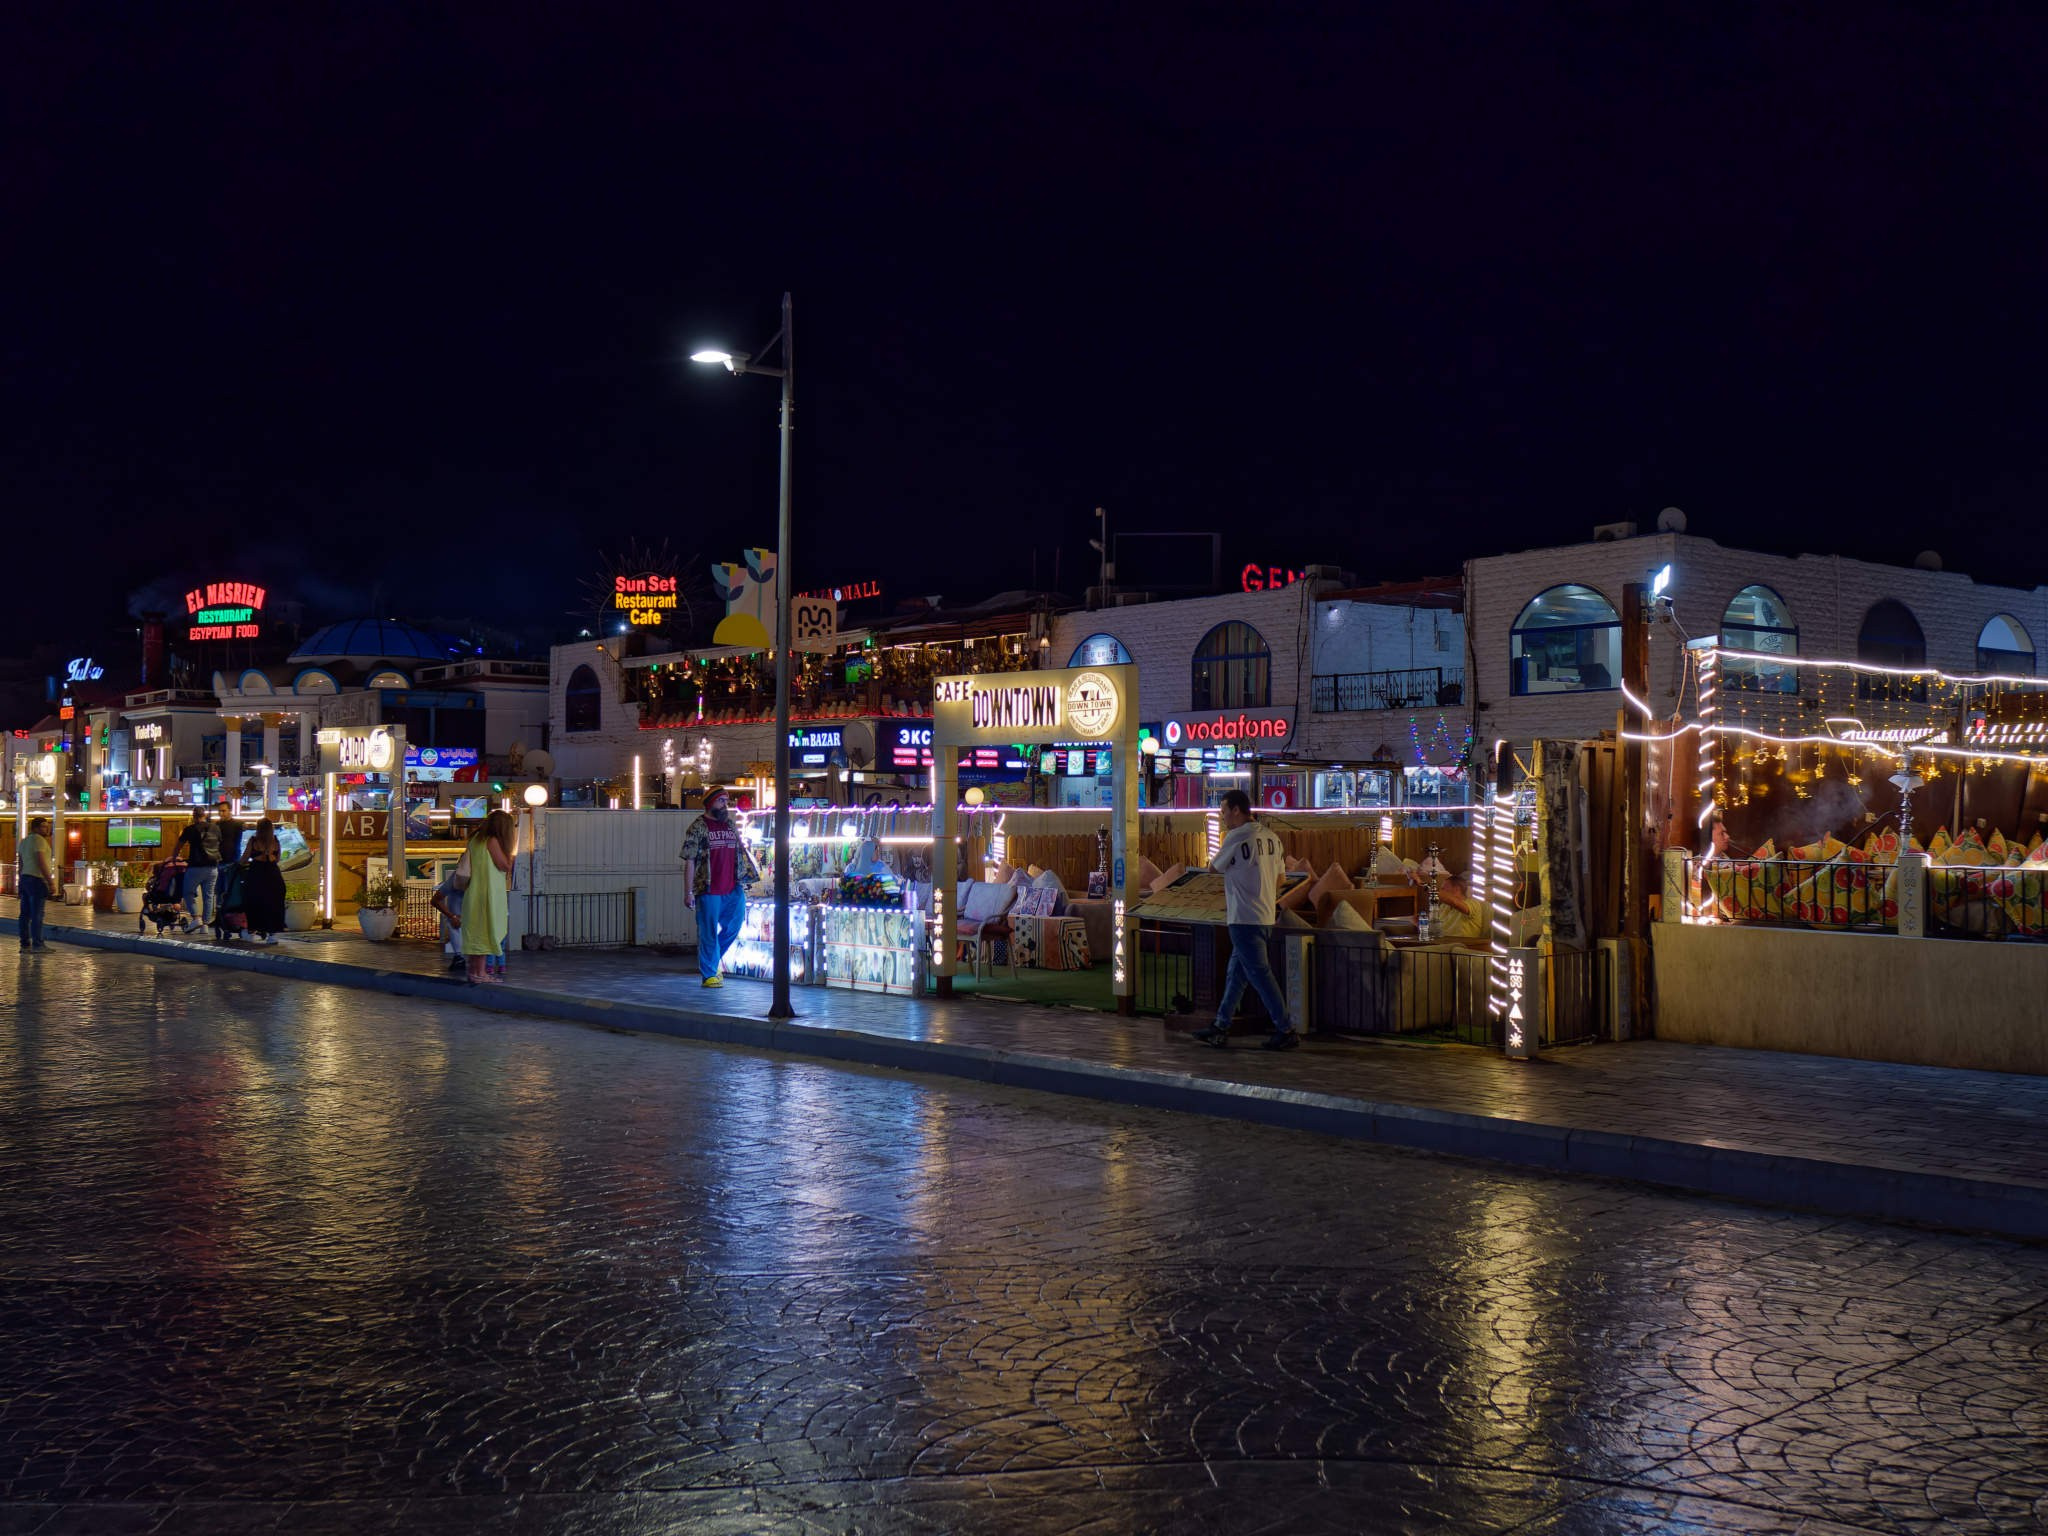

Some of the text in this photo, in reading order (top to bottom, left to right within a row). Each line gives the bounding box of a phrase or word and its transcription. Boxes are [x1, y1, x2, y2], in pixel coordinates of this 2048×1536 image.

[615, 575, 677, 592] Sun Set
[842, 580, 881, 601] MALL
[186, 582, 266, 614] EL MASRIEN
[615, 593, 677, 609] Restaurant
[198, 608, 253, 624] RESTAURANT
[630, 609, 662, 625] Cafe
[189, 624, 259, 641] EGYPTIAN FOOD
[935, 682, 970, 702] CAFE
[972, 687, 1056, 728] DOWNTOWN
[1068, 700, 1111, 710] DOWN TOWN
[135, 723, 162, 741] Violet Spa
[1185, 714, 1288, 740] vodafone
[810, 732, 841, 747] BAZAR
[899, 729, 934, 745] ЭКС
[339, 736, 369, 766] CAIRO
